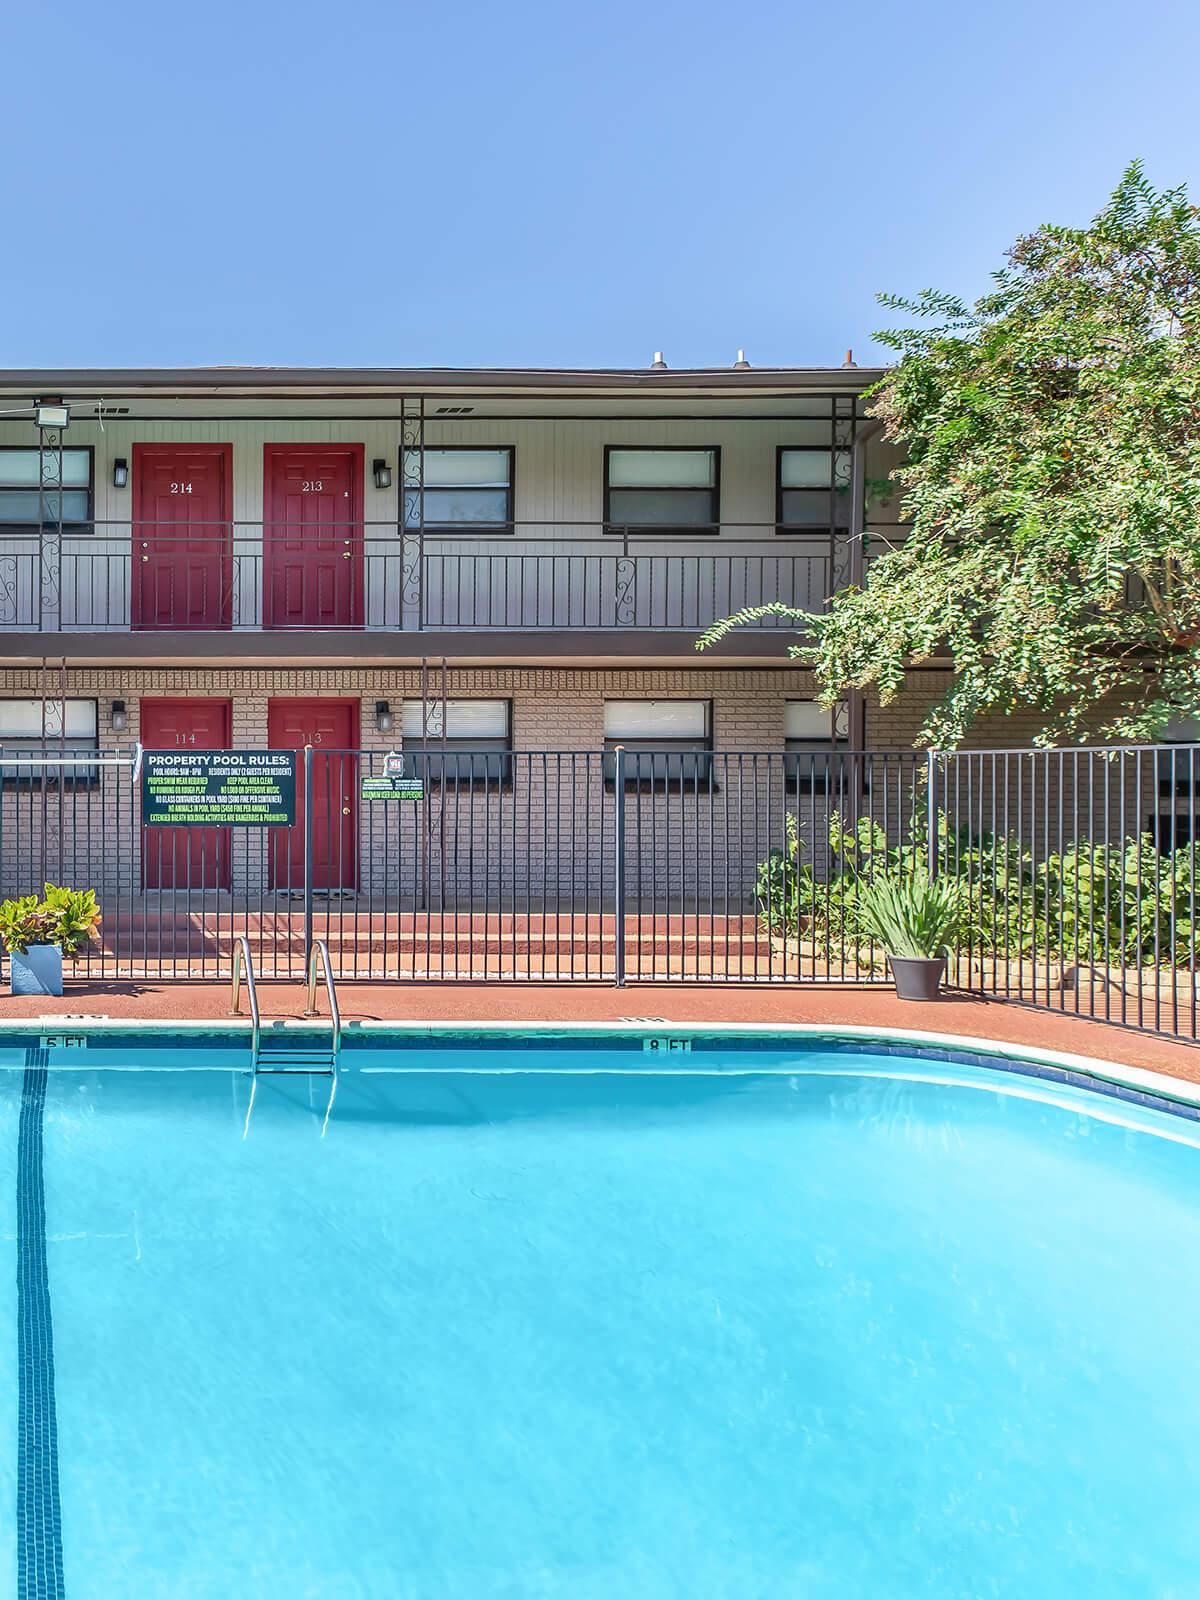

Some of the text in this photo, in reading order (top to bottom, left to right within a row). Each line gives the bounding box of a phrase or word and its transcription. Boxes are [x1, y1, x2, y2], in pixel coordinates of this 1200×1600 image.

[170, 482, 192, 494] 214
[302, 481, 322, 492] 213
[175, 733, 196, 744] 114
[302, 733, 322, 744] 113
[149, 756, 289, 765] PROPERTY POOL RULES:
[47, 1038, 84, 1047] 5 FT
[670, 1040, 688, 1050] FT
